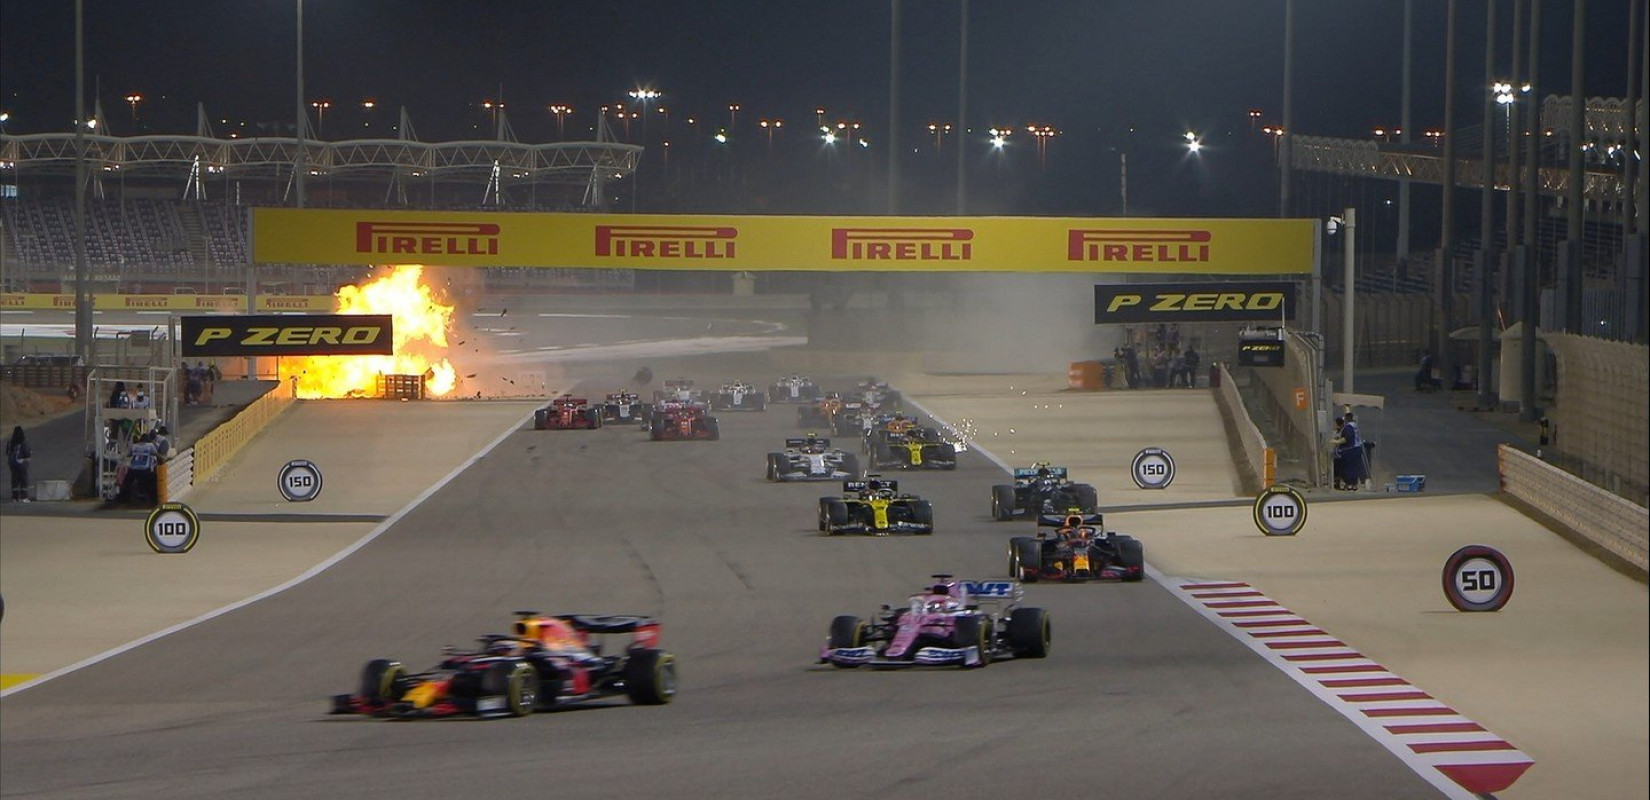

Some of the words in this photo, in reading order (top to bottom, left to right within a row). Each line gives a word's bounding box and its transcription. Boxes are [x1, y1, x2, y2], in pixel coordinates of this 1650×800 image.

[356, 222, 500, 255] PIRELLI
[594, 225, 738, 258] PIRELLI
[831, 228, 974, 261] PIRELLI
[1067, 230, 1211, 262] PIRELLI
[1107, 295, 1141, 312] P
[1150, 293, 1283, 311] ZERO
[195, 328, 232, 346] P
[241, 327, 381, 345] ZERO
[1296, 392, 1304, 406] F
[1142, 464, 1164, 475] 150
[289, 476, 311, 487] 150
[1267, 505, 1294, 518] 100
[158, 523, 186, 535] 100
[1462, 570, 1495, 591] 50
